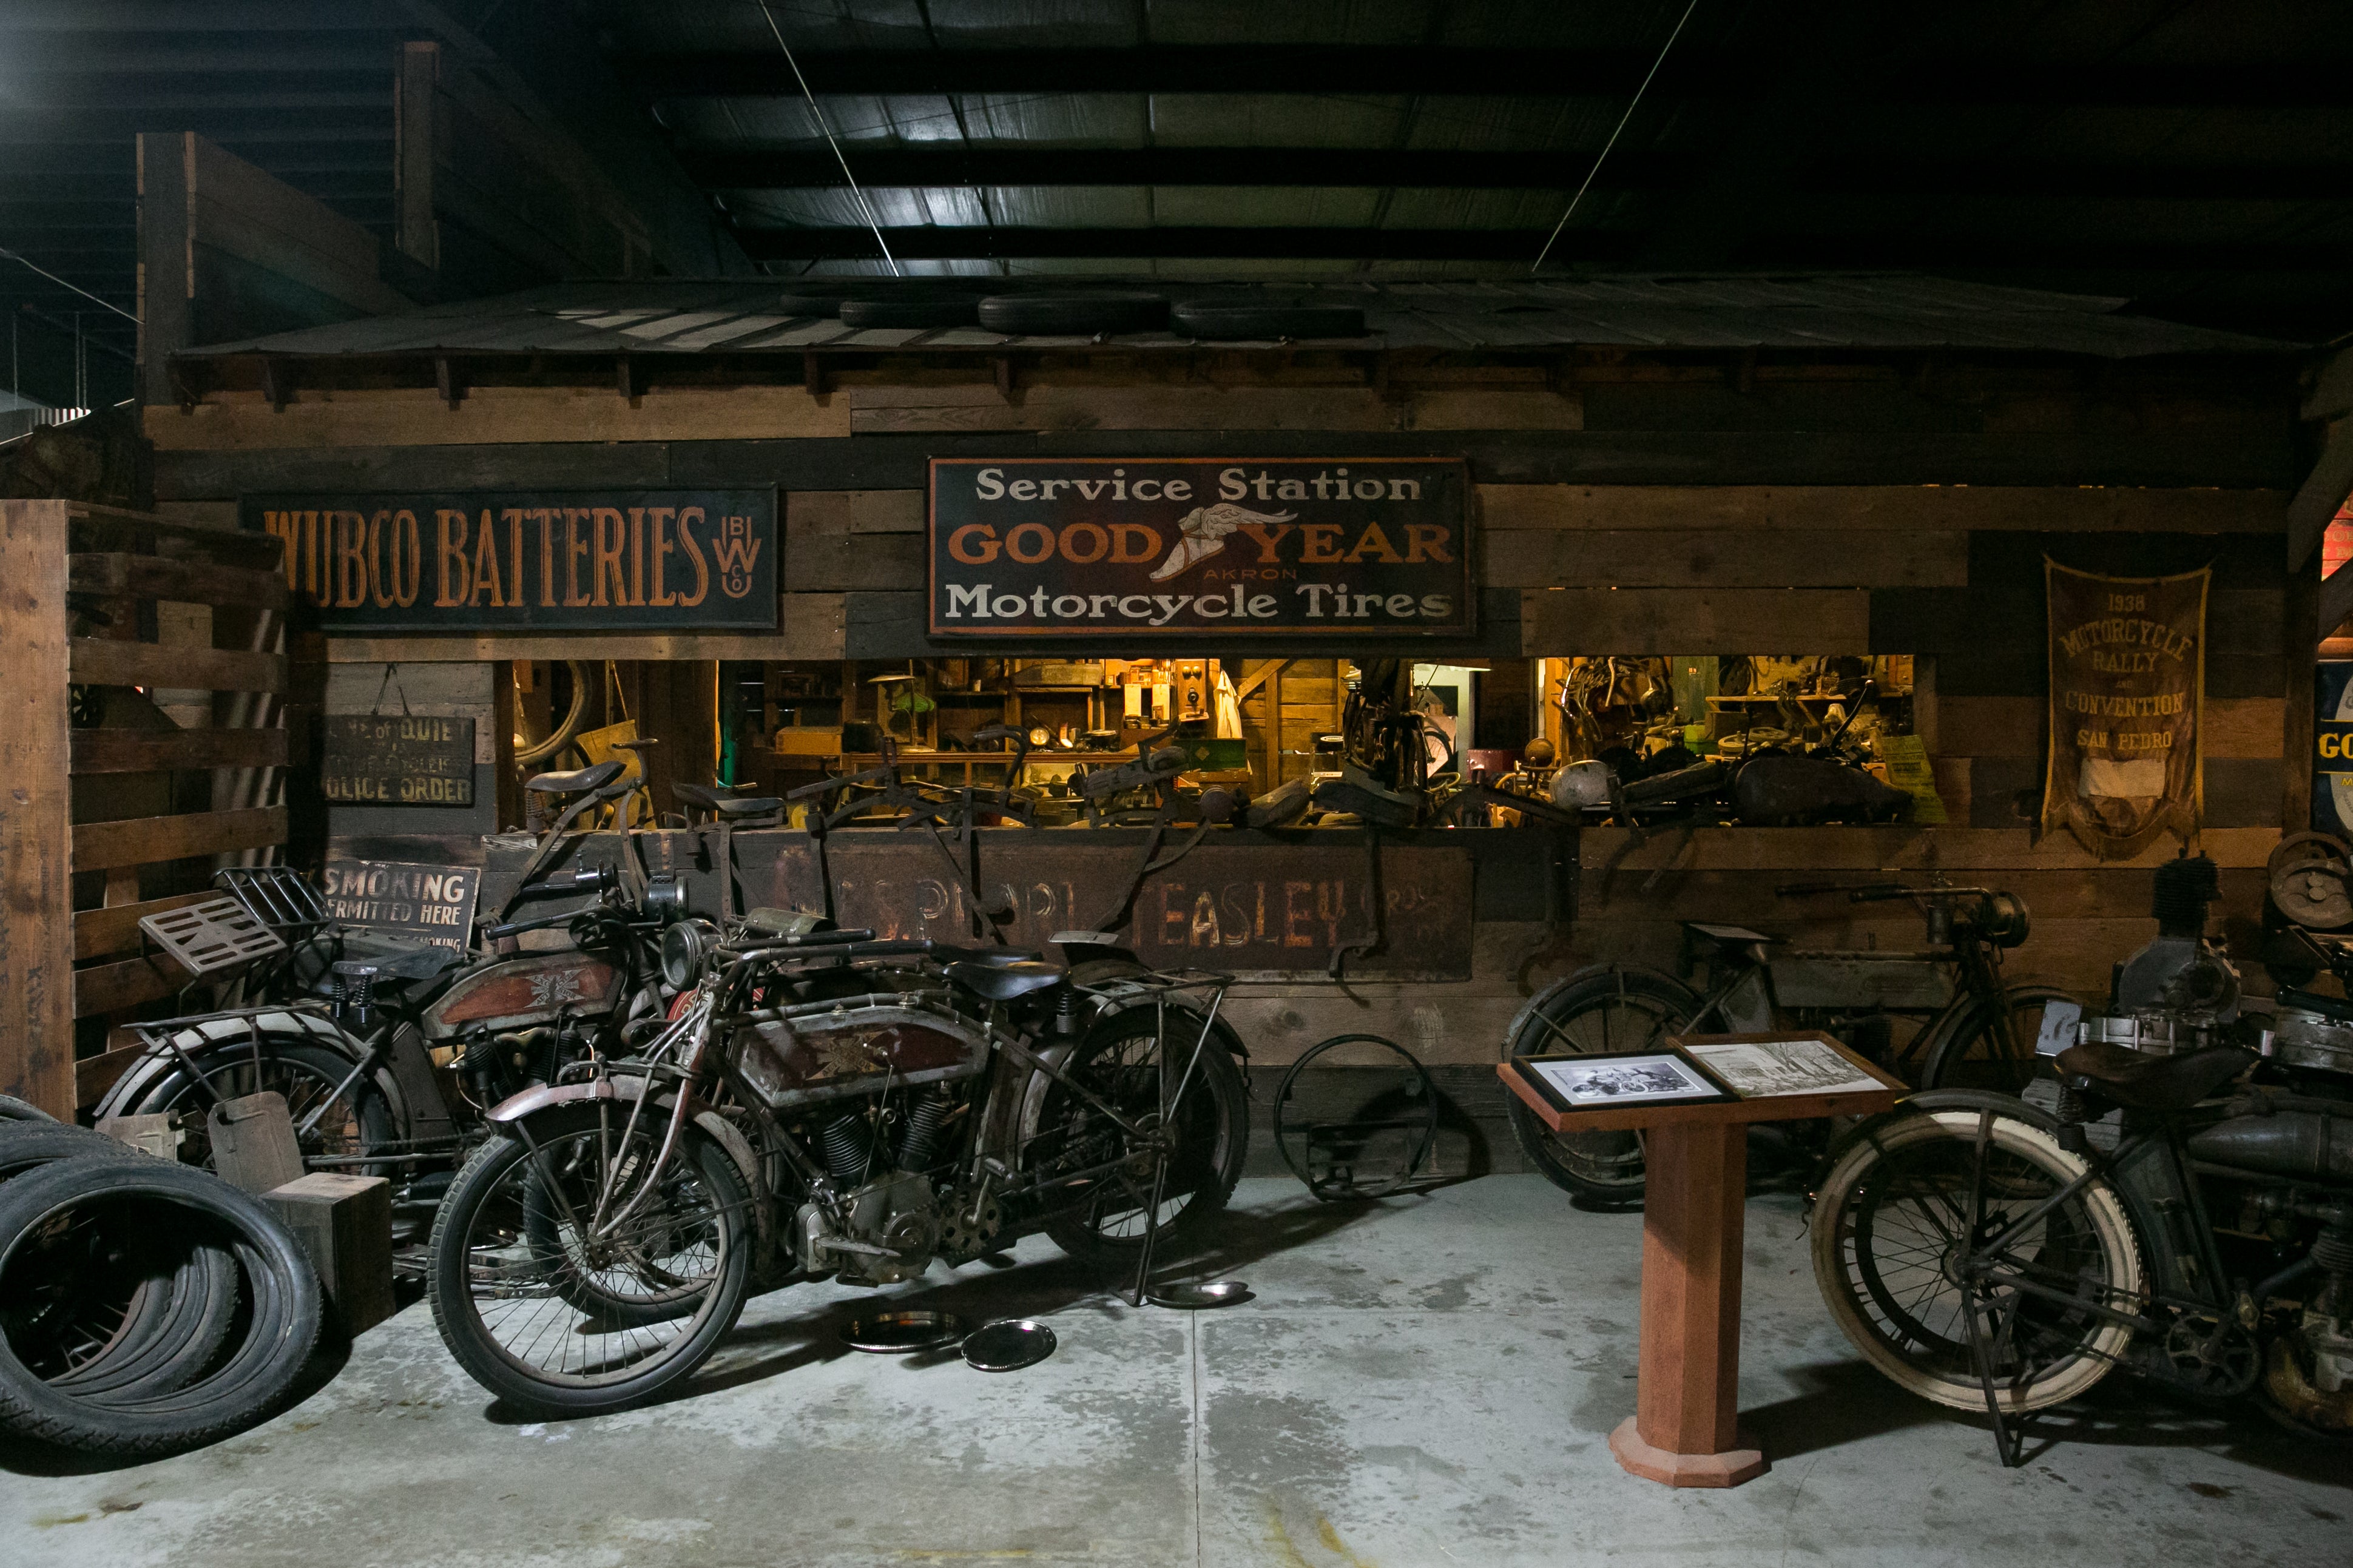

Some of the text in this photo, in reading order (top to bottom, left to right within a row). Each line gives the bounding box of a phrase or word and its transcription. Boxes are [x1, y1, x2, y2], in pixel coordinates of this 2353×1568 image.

[976, 466, 1421, 500] Service Station
[433, 506, 708, 608] BATTERIES
[948, 521, 1454, 565] GOOD YEAR
[1203, 569, 1297, 580] AKRON
[945, 584, 1454, 626] Motorcycle Tires
[2108, 593, 2145, 612] 1938
[2059, 617, 2194, 662] MOTORCYCLE
[2092, 651, 2159, 673] RALLY
[2065, 690, 2184, 718] CONVENTION
[2077, 728, 2172, 751] SAN PEDRO
[325, 775, 472, 803] OLICE ORDER
[324, 867, 465, 904] SMOKING
[420, 904, 462, 926] HERE
